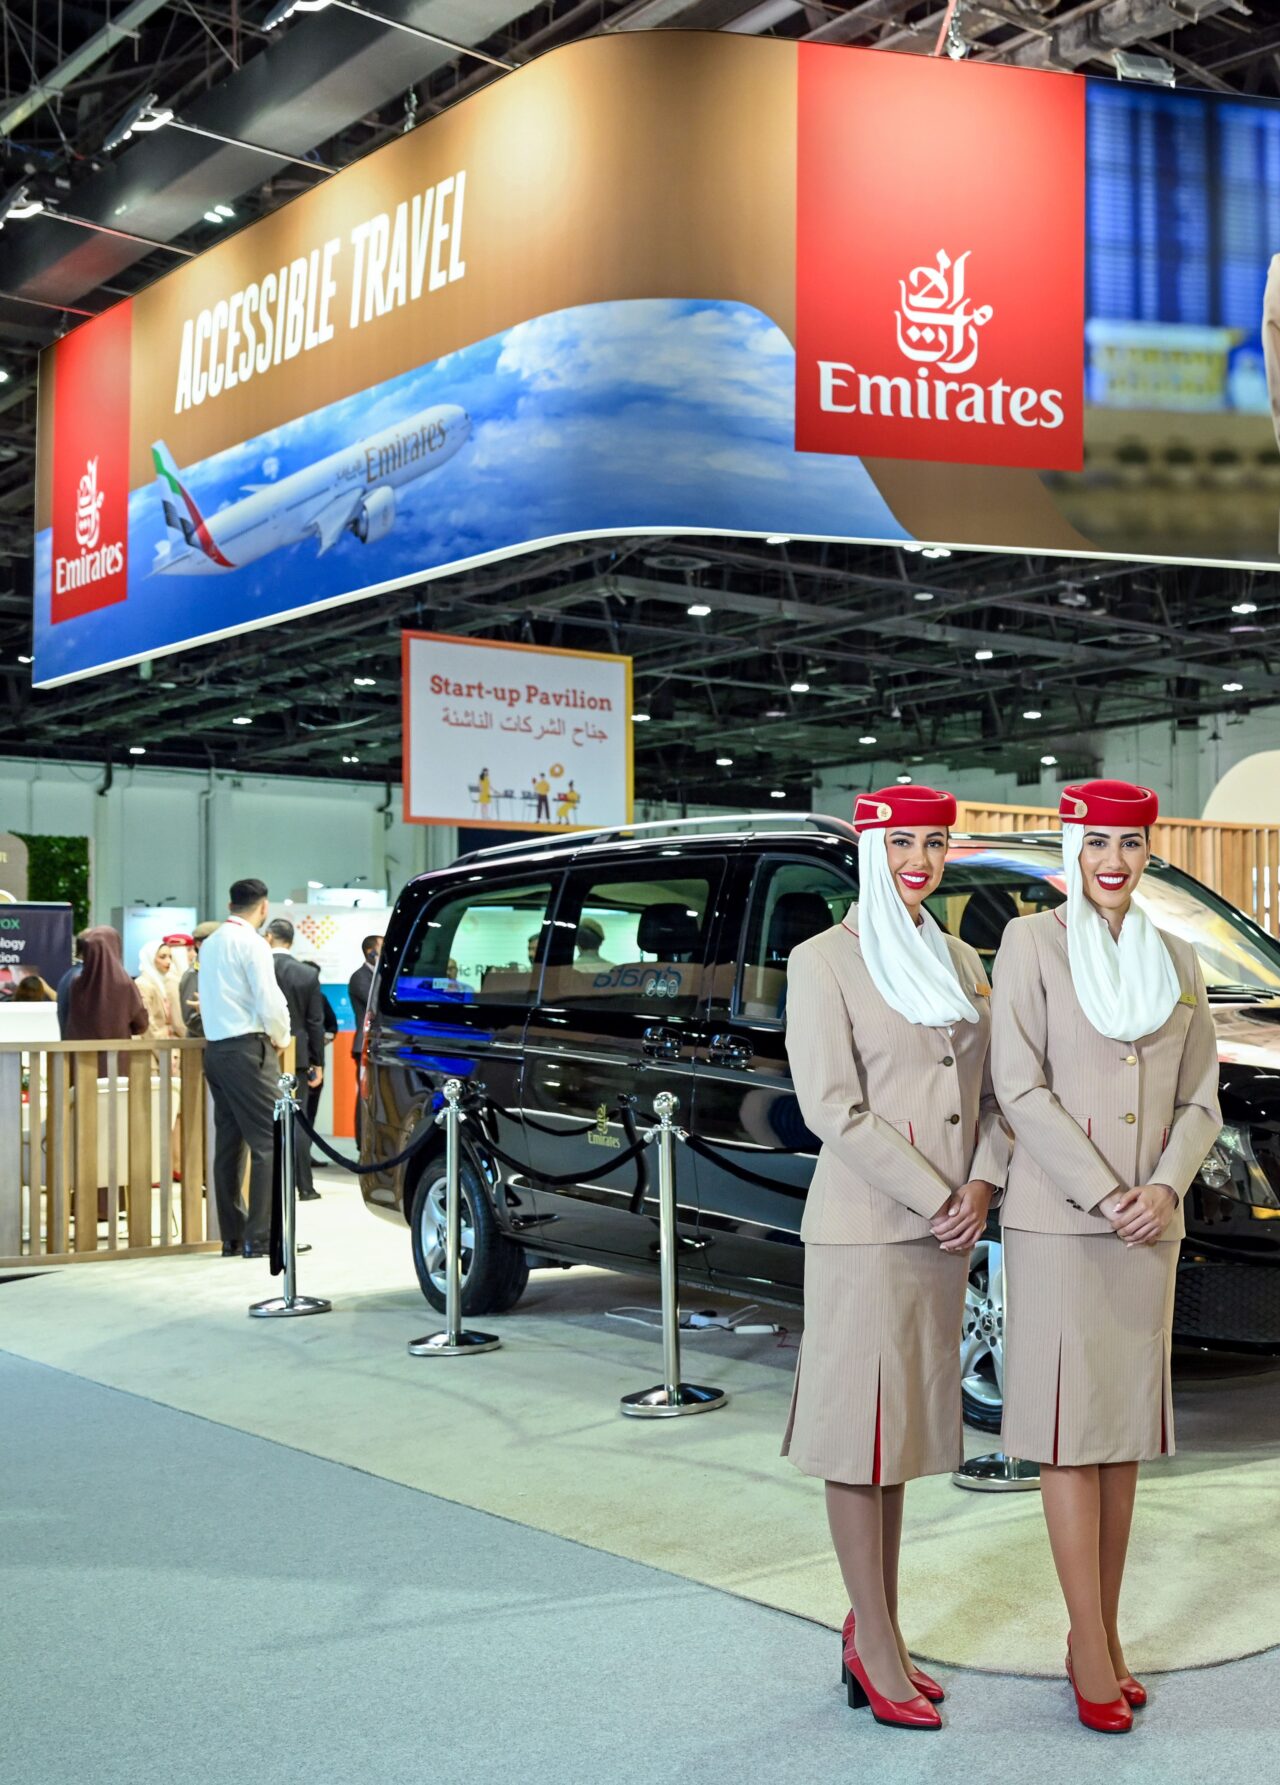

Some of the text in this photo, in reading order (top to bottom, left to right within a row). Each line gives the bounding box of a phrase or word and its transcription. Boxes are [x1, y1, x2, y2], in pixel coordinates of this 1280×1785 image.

[174, 170, 467, 415] ACCESSIBLE TRAVEL
[816, 360, 1064, 429] Emirates
[364, 418, 448, 484] Emirates
[55, 542, 124, 595] Emirates
[430, 674, 613, 712] Start-up Pavilion
[442, 707, 609, 747] جناح الشركات الناشئة
[587, 1131, 621, 1149] Emirates
